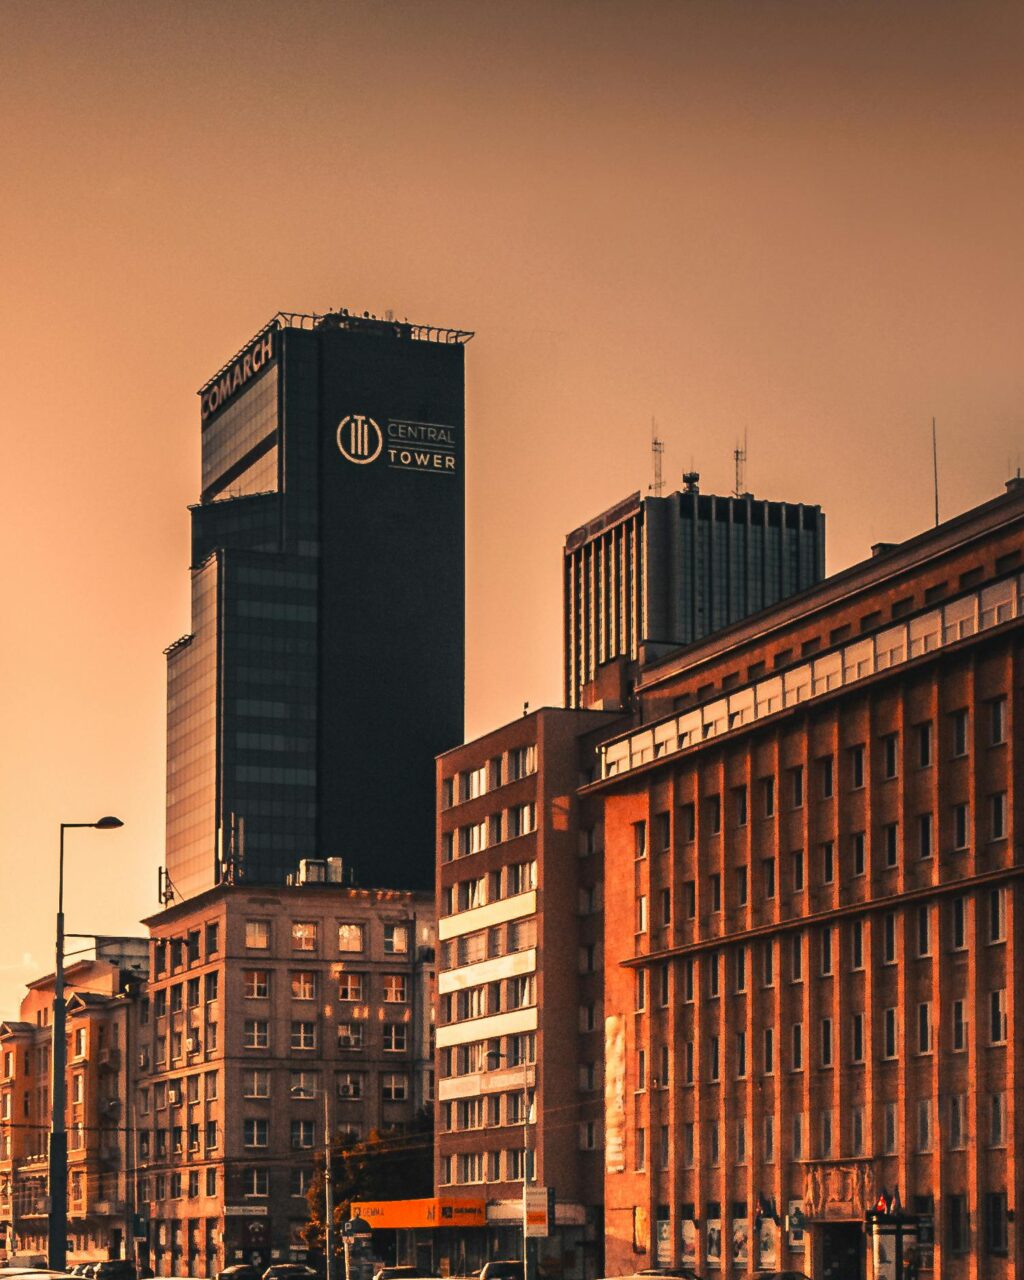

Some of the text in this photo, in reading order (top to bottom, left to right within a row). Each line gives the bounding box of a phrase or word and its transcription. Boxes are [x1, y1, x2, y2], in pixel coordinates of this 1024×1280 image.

[202, 333, 273, 420] COMARCH
[387, 423, 456, 443] CENTRAL
[388, 449, 456, 469] TOWER
